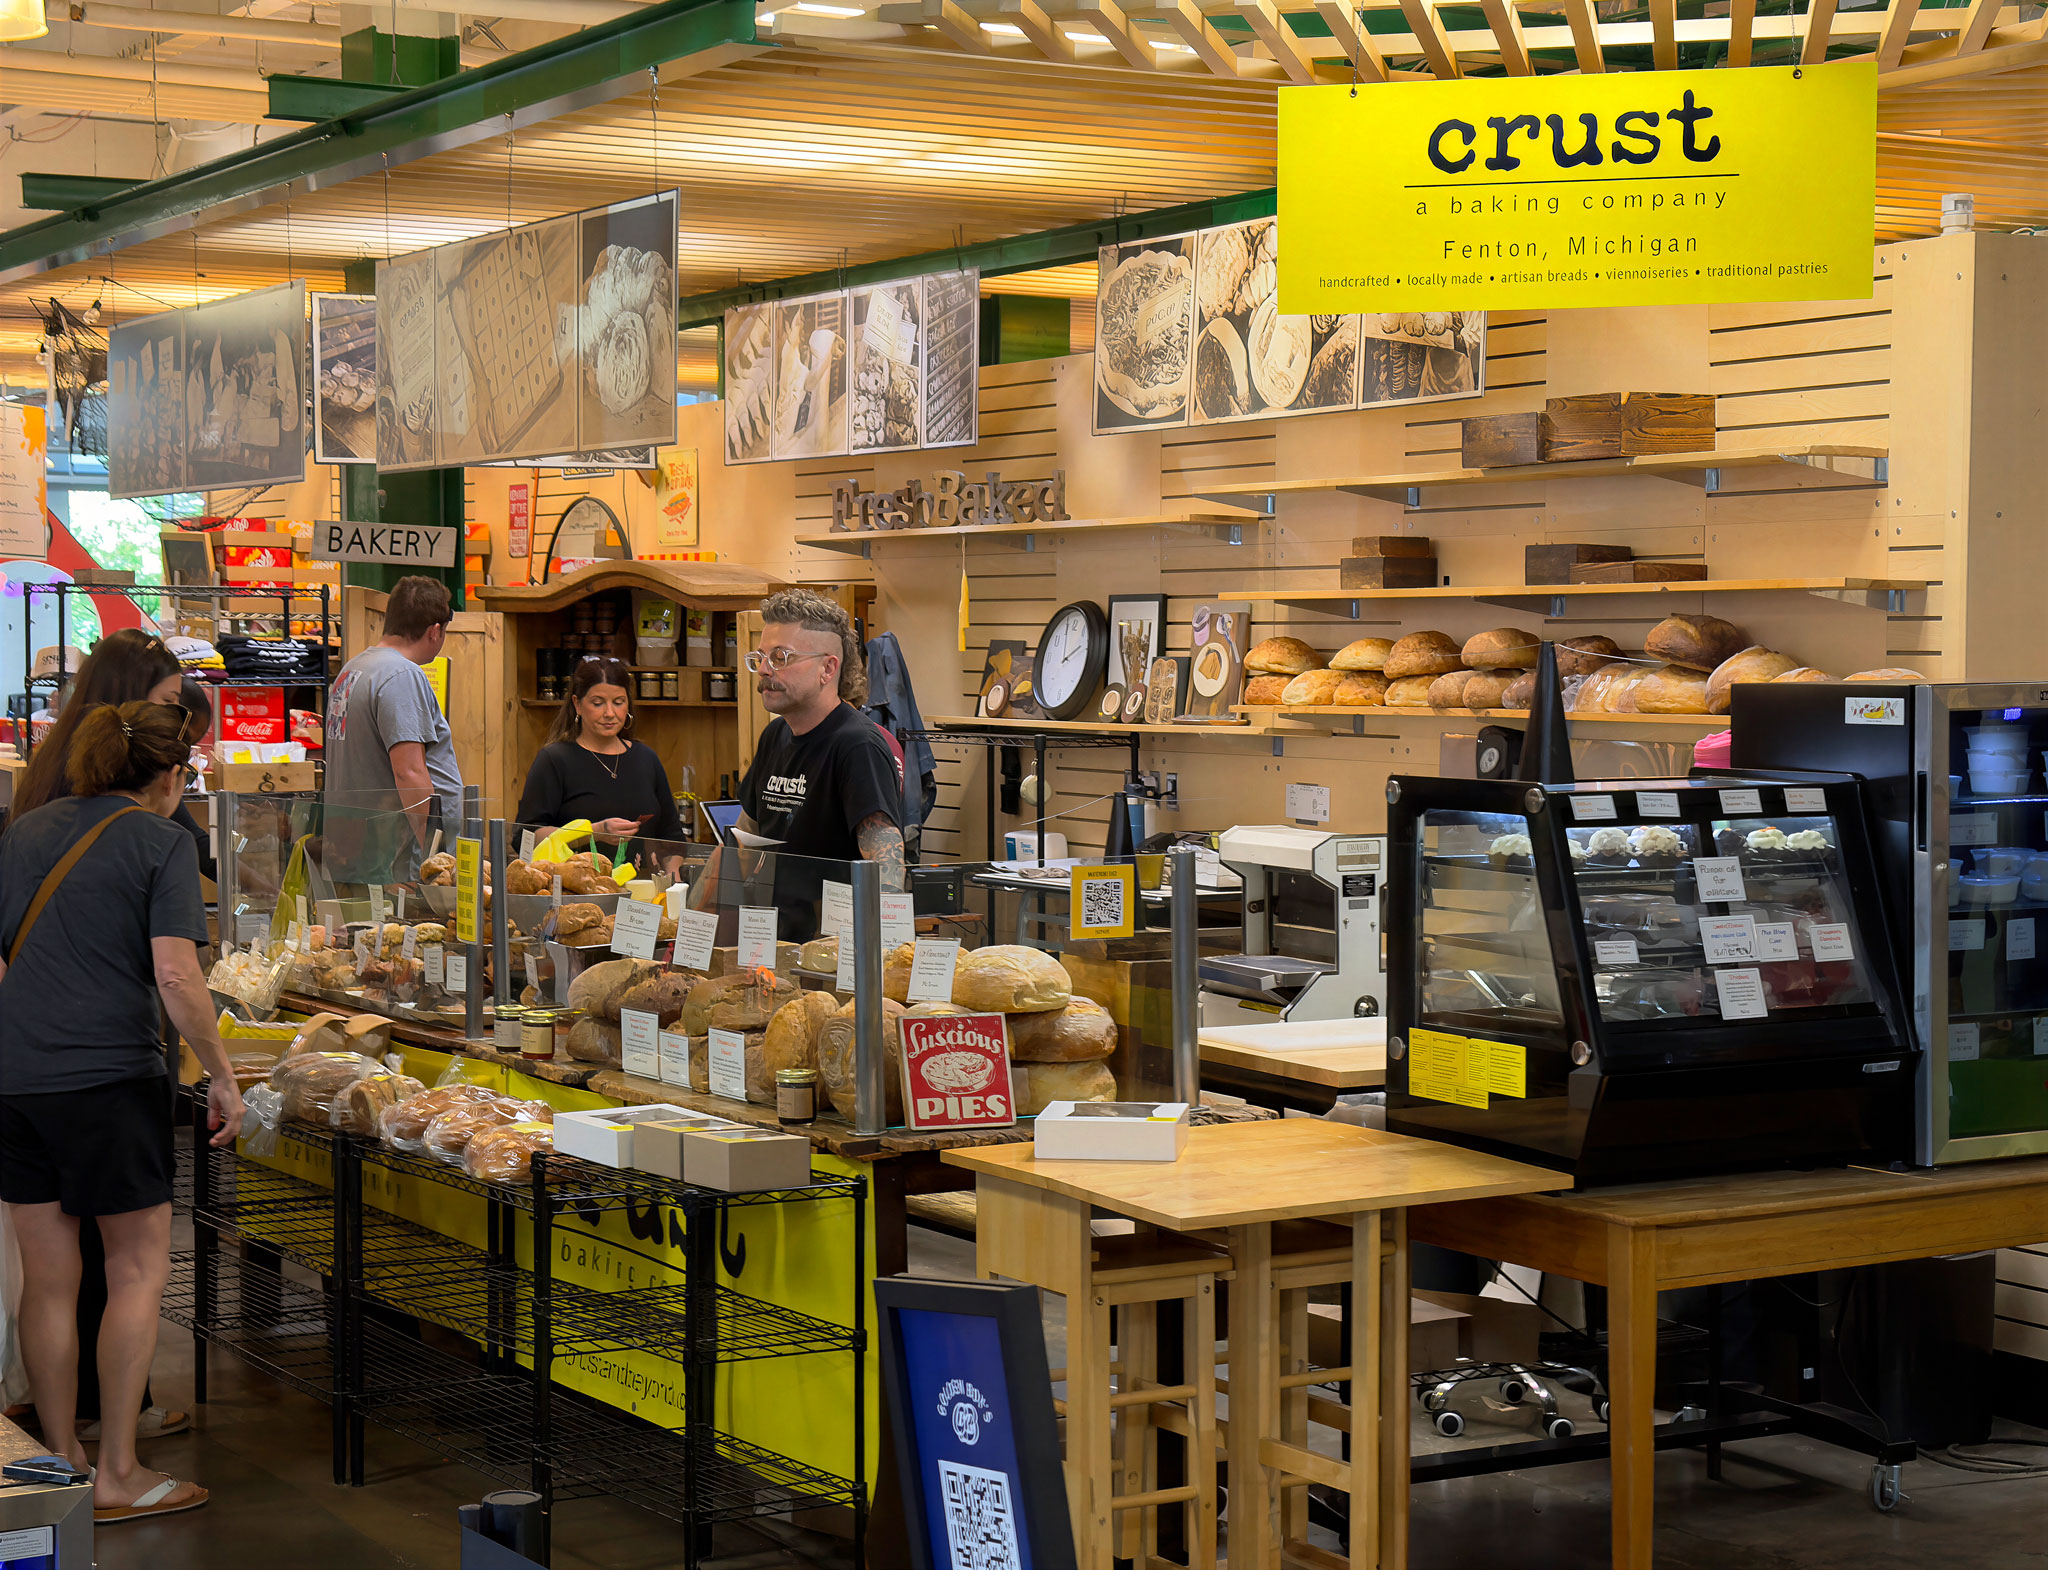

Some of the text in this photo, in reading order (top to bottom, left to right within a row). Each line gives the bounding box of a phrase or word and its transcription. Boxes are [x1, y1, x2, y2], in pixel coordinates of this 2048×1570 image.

[1428, 89, 1721, 174] crust
[1416, 189, 1729, 216] a baking company
[1444, 234, 1699, 261] Fenton, Michigan
[1319, 262, 1830, 289] handcrafted locally made artisan breads viennoiseries traditional pastries
[328, 525, 443, 558] BAKERY
[767, 774, 807, 794] crust
[908, 1021, 1003, 1059] Luscious
[916, 1094, 1007, 1120] PIES
